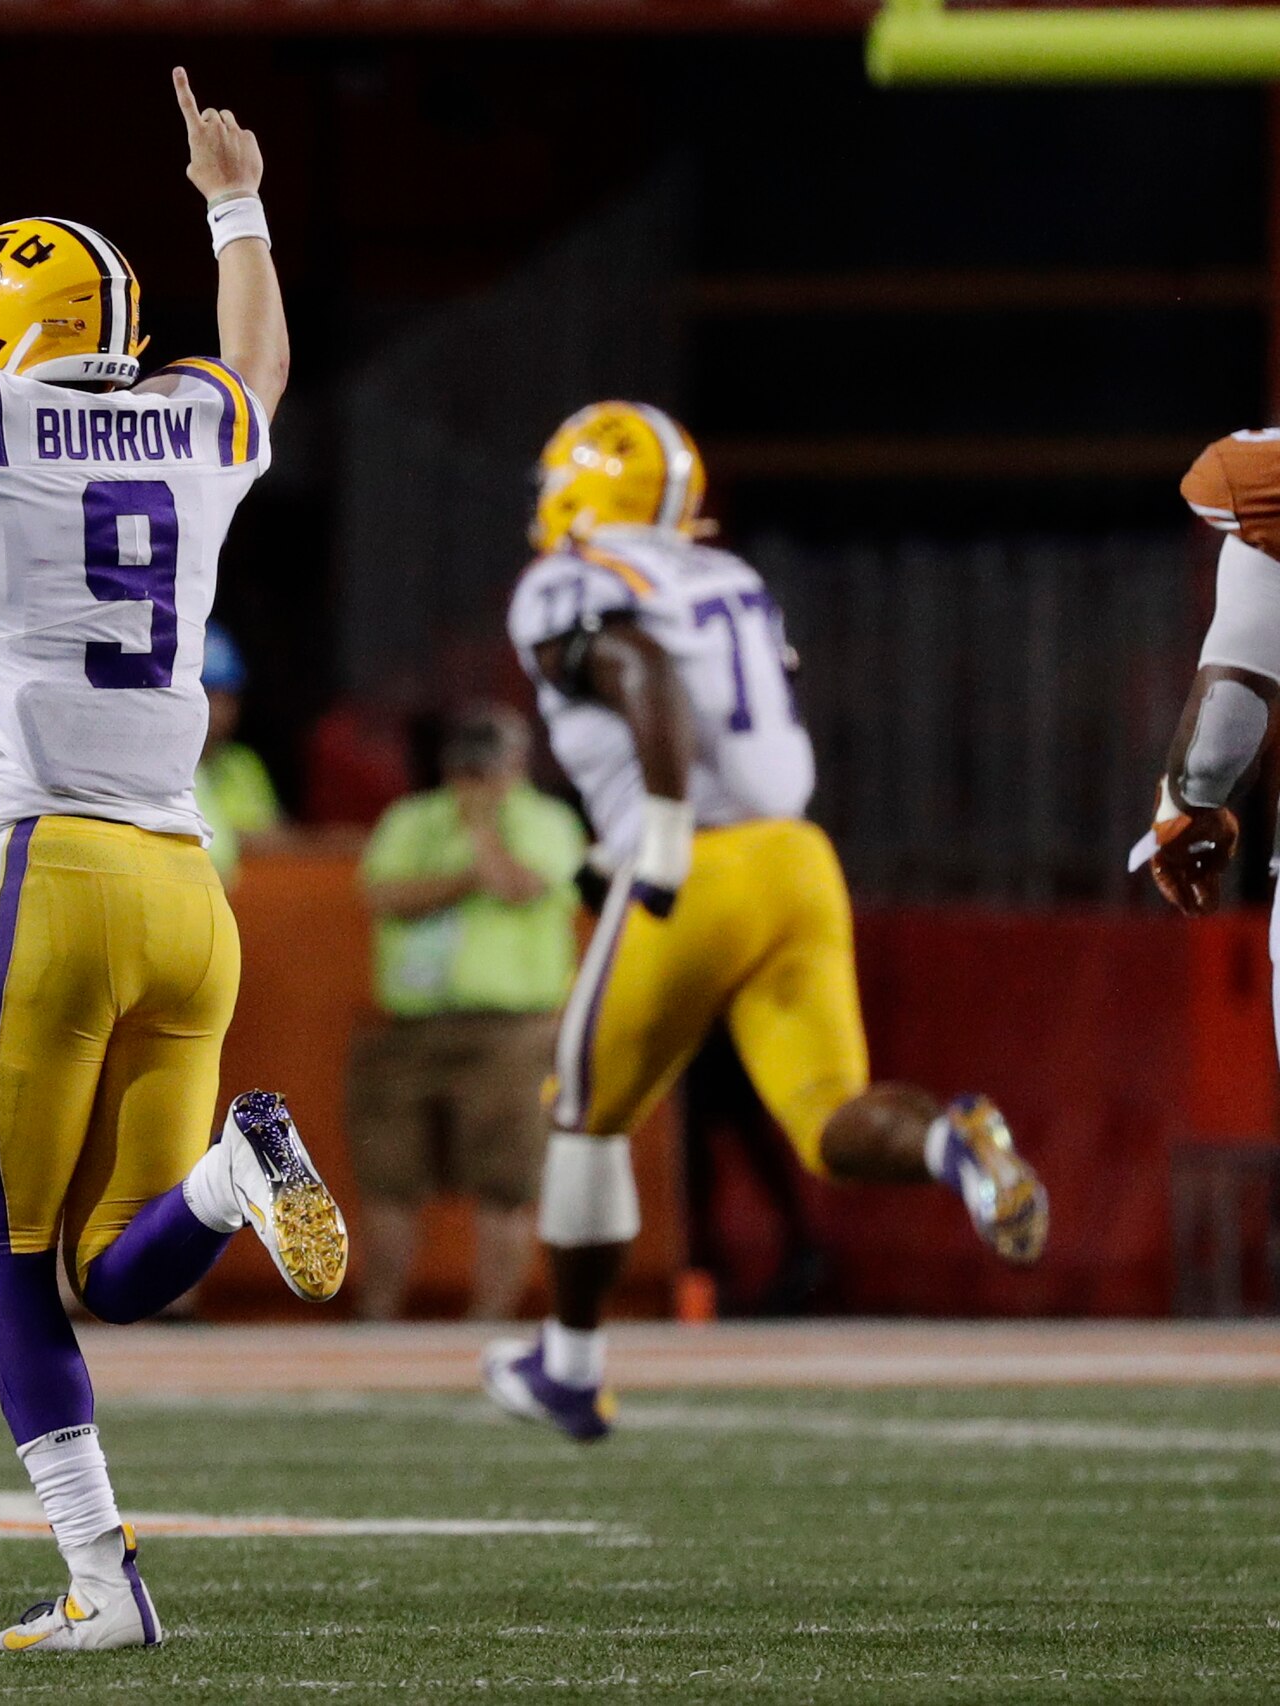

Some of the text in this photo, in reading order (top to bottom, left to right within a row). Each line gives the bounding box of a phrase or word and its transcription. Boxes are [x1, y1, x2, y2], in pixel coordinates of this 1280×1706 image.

[36, 407, 193, 461] BURROW
[82, 480, 179, 688] 9
[54, 1427, 91, 1443] GRIP
